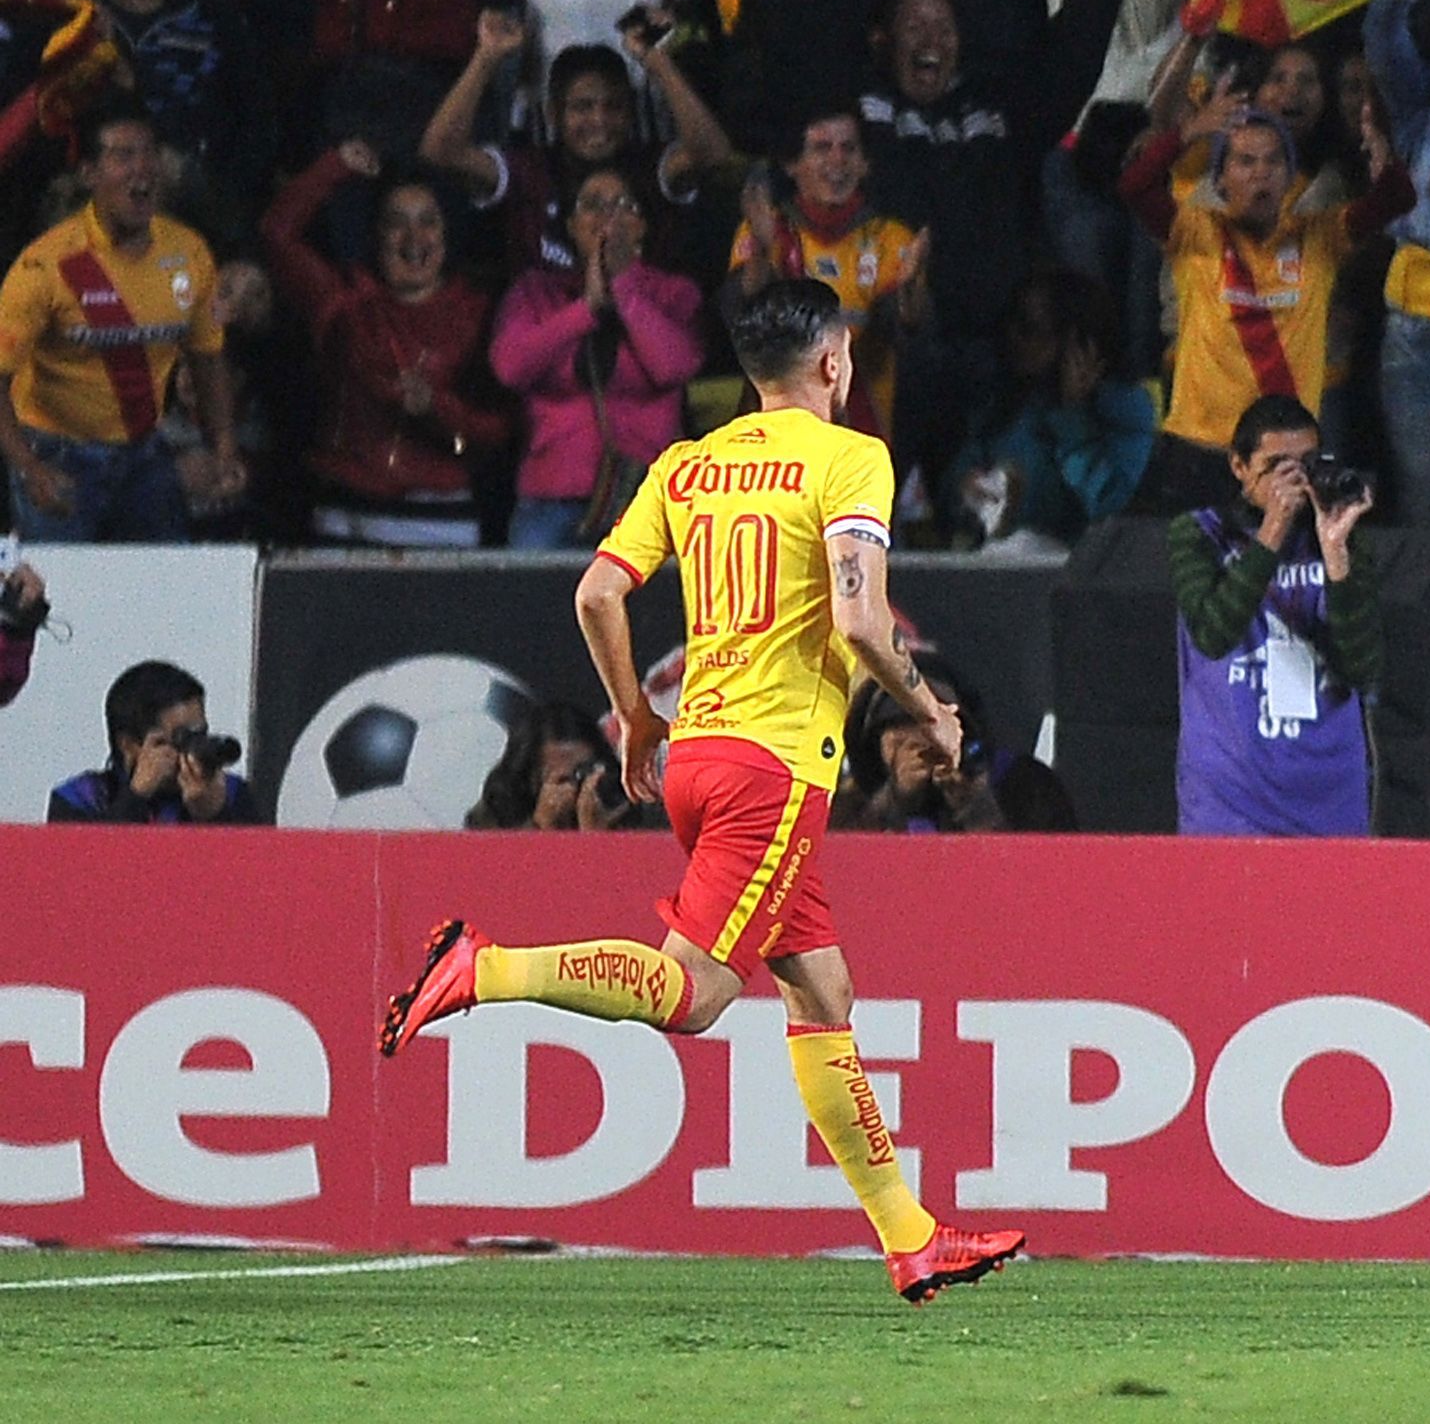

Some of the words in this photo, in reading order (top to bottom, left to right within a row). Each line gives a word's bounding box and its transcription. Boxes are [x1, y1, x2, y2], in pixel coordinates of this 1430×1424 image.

[667, 454, 806, 510] Corona
[682, 513, 778, 636] 10
[557, 947, 648, 1002] Totalplay
[844, 1071, 896, 1169] Totalplay
